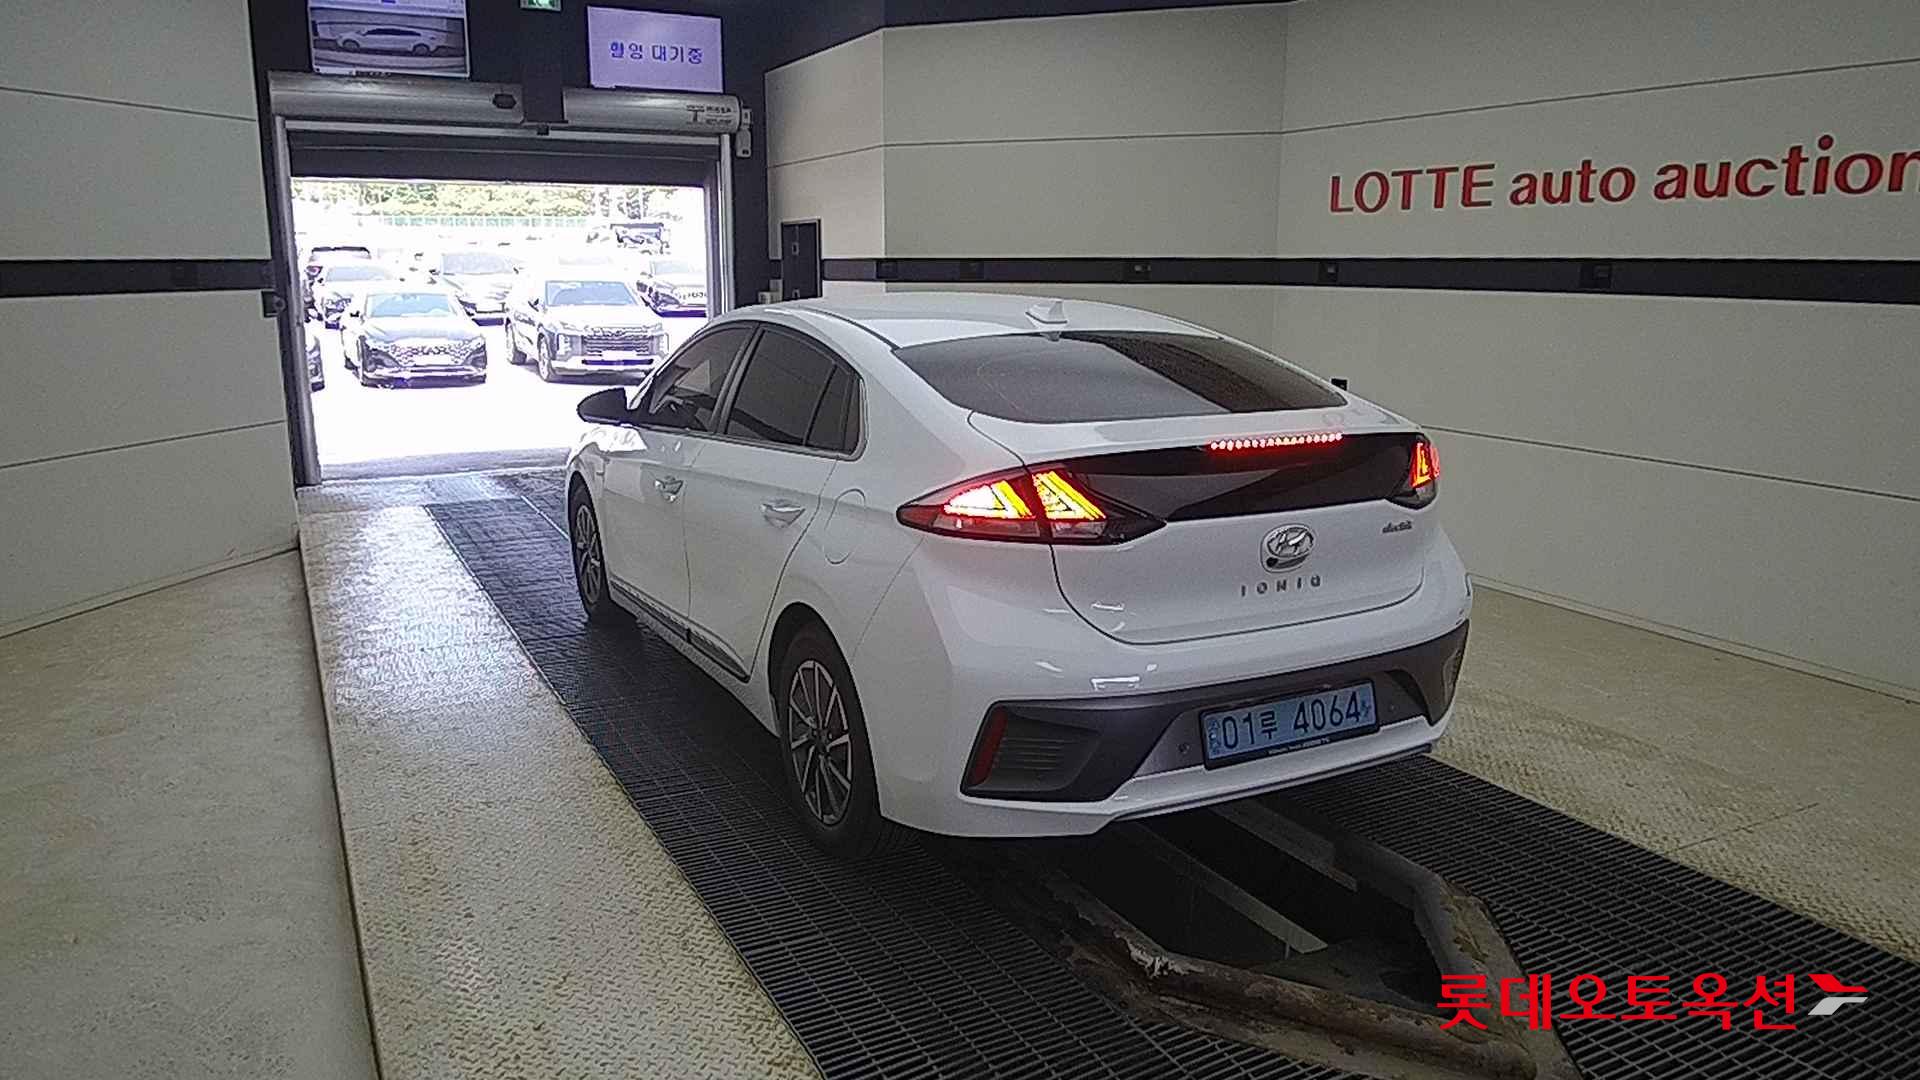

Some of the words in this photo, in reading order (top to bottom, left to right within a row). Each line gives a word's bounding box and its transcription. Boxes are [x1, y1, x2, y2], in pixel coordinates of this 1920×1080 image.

[652, 44, 703, 65] 대기중
[1329, 162, 1496, 213] LOTTE
[1509, 159, 1637, 206] auto
[1241, 575, 1321, 597] IONIQ
[1222, 709, 1278, 750] 01루
[1293, 690, 1361, 734] 4064
